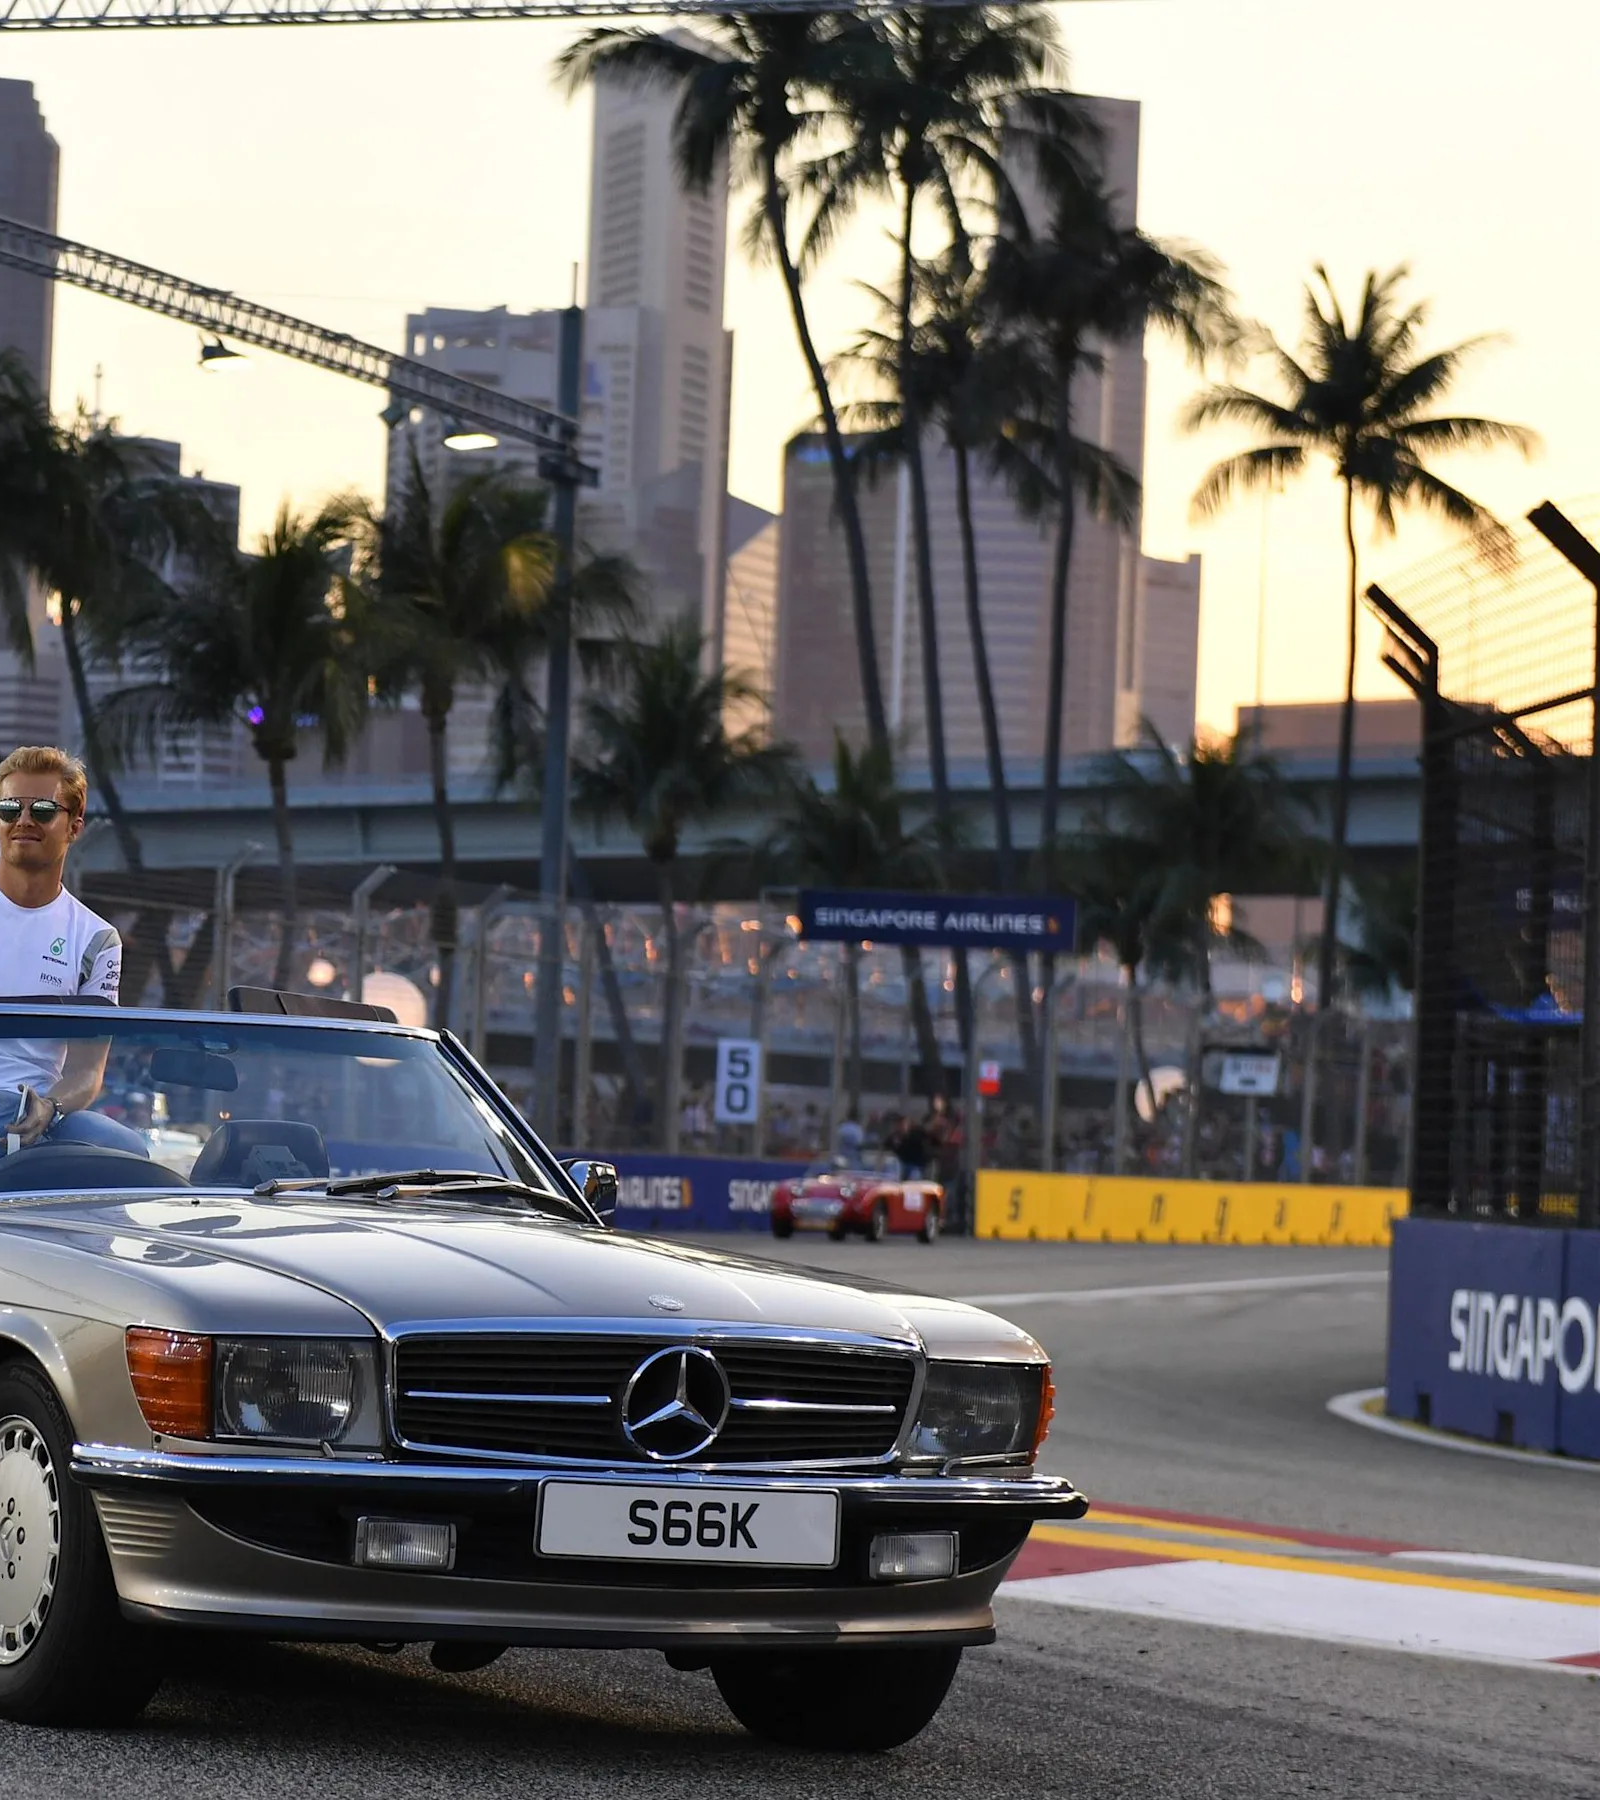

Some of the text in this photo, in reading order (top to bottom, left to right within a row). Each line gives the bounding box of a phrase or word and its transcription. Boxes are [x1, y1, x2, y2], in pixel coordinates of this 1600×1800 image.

[814, 906, 1045, 935] SINGAPORE AIRLINES
[40, 972, 63, 985] BOSS
[42, 955, 68, 967] PETRONAS
[616, 1175, 681, 1210] AIRLINES
[728, 1178, 777, 1213] SINGA
[1448, 1288, 1600, 1395] SINGAPO
[627, 1499, 760, 1549] S66K
